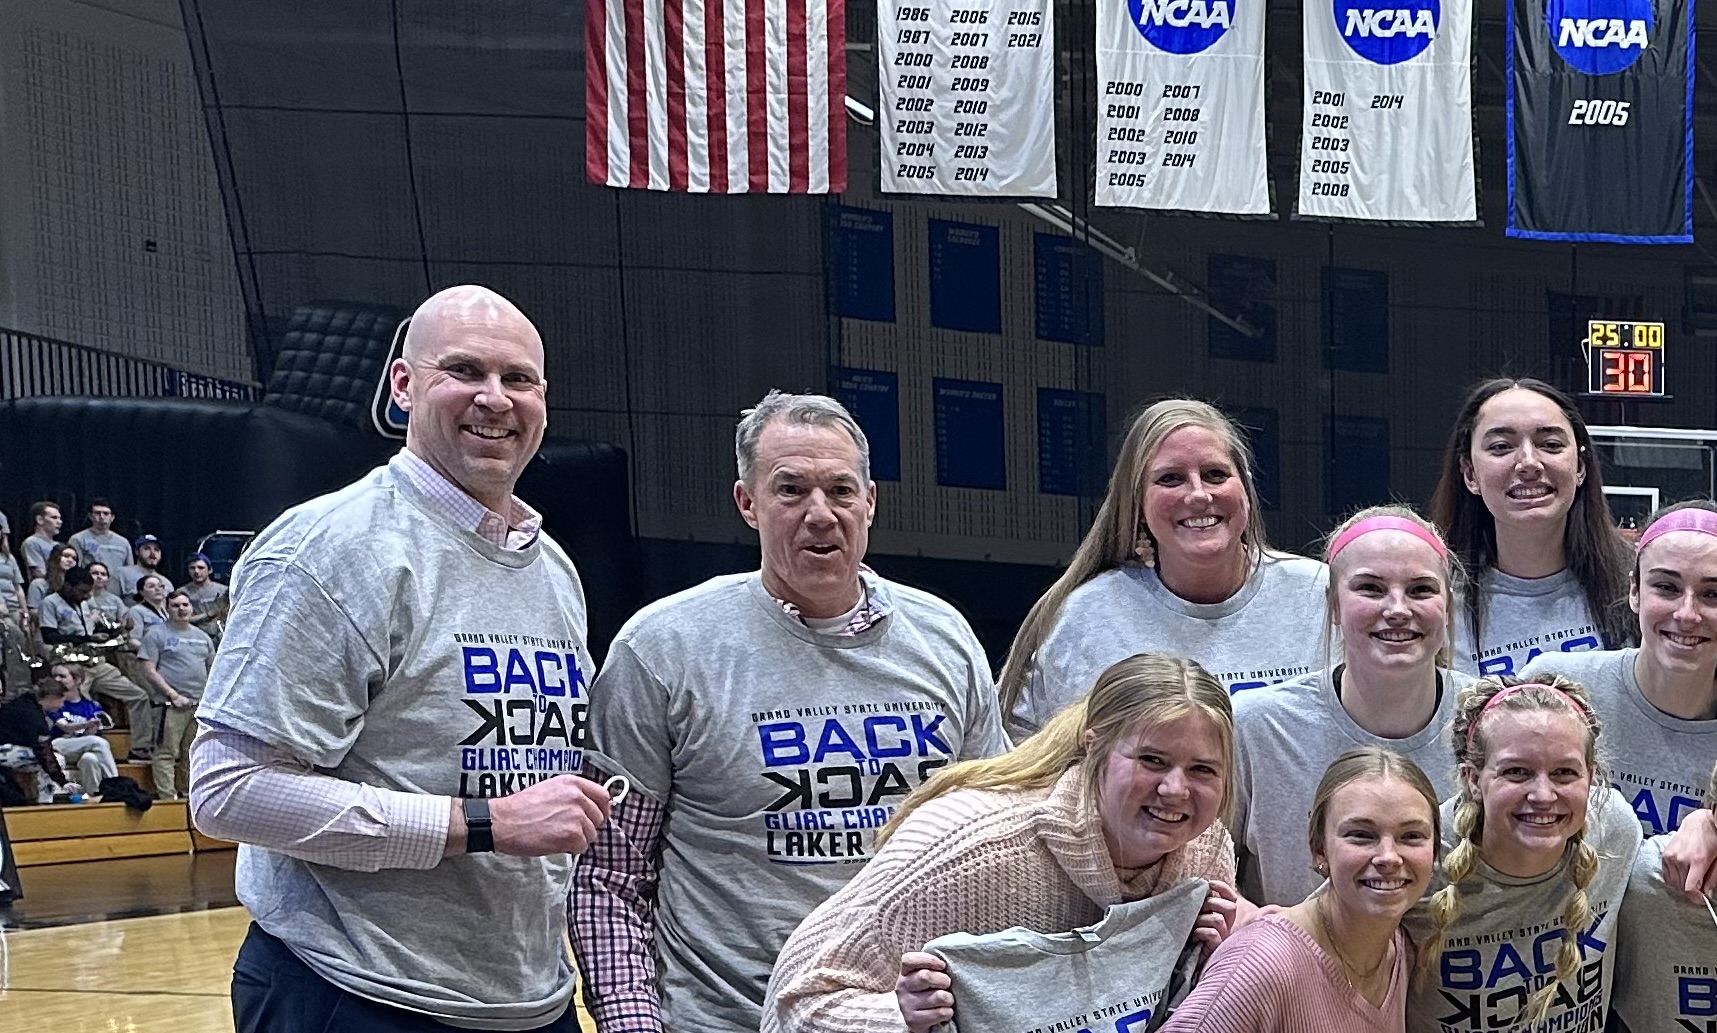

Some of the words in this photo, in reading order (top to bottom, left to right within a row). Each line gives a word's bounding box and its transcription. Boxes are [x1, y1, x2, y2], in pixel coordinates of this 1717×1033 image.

[896, 7, 930, 22] 1986
[949, 10, 988, 24] 2006
[1008, 11, 1041, 26] 2015
[1139, 0, 1231, 29] NCAA
[1344, 9, 1435, 39] NCAA
[1559, 18, 1648, 48] NCAA
[897, 30, 931, 44] 1987
[951, 33, 988, 47] 2007
[1008, 34, 1041, 48] 2021
[894, 52, 933, 67] 2000
[951, 55, 988, 70] 2008
[897, 75, 931, 89] 2001
[951, 78, 989, 92] 2009
[1106, 82, 1143, 97] 2000
[1163, 85, 1200, 99] 2007
[896, 97, 933, 112] 2002
[954, 100, 987, 115] 2010
[1312, 91, 1345, 107] 2001
[1371, 95, 1404, 109] 2014
[1107, 105, 1139, 120] 2001
[1164, 108, 1200, 122] 2008
[1312, 114, 1349, 129] 2002
[1569, 100, 1630, 126] 2005
[896, 120, 934, 135] 2003
[954, 123, 987, 137] 2012
[1108, 128, 1145, 142] 2002
[1164, 131, 1197, 145] 2010
[897, 142, 934, 157] 2004
[954, 145, 988, 160] 2013
[1312, 137, 1349, 151] 2003
[1108, 151, 1146, 165] 2003
[1162, 153, 1196, 168] 2014
[1312, 159, 1350, 174] 2005
[897, 165, 936, 180] 2005
[954, 167, 989, 182] 2014
[1109, 173, 1146, 187] 2005
[1312, 182, 1349, 197] 2008
[1592, 324, 1661, 347] 25:00
[1603, 353, 1649, 391] 30
[489, 635, 518, 645] VALLEY
[1506, 637, 1540, 651] VALLEY
[1545, 629, 1575, 641] STATE
[752, 710, 790, 723] GRAND
[797, 706, 838, 717] VALLEY
[844, 703, 879, 714] STATE
[885, 701, 946, 712] UNIVERSITY
[758, 715, 952, 767] BACK
[462, 748, 520, 771] GLIAC
[855, 758, 881, 776] TO
[1620, 772, 1655, 787] VALLEY
[1660, 781, 1691, 794] STATE
[764, 810, 835, 830] GLIAC
[766, 831, 864, 857] LAKER
[1440, 911, 1608, 990] BACK
[1674, 965, 1709, 975] GRAND
[1093, 1001, 1129, 1020] STATE
